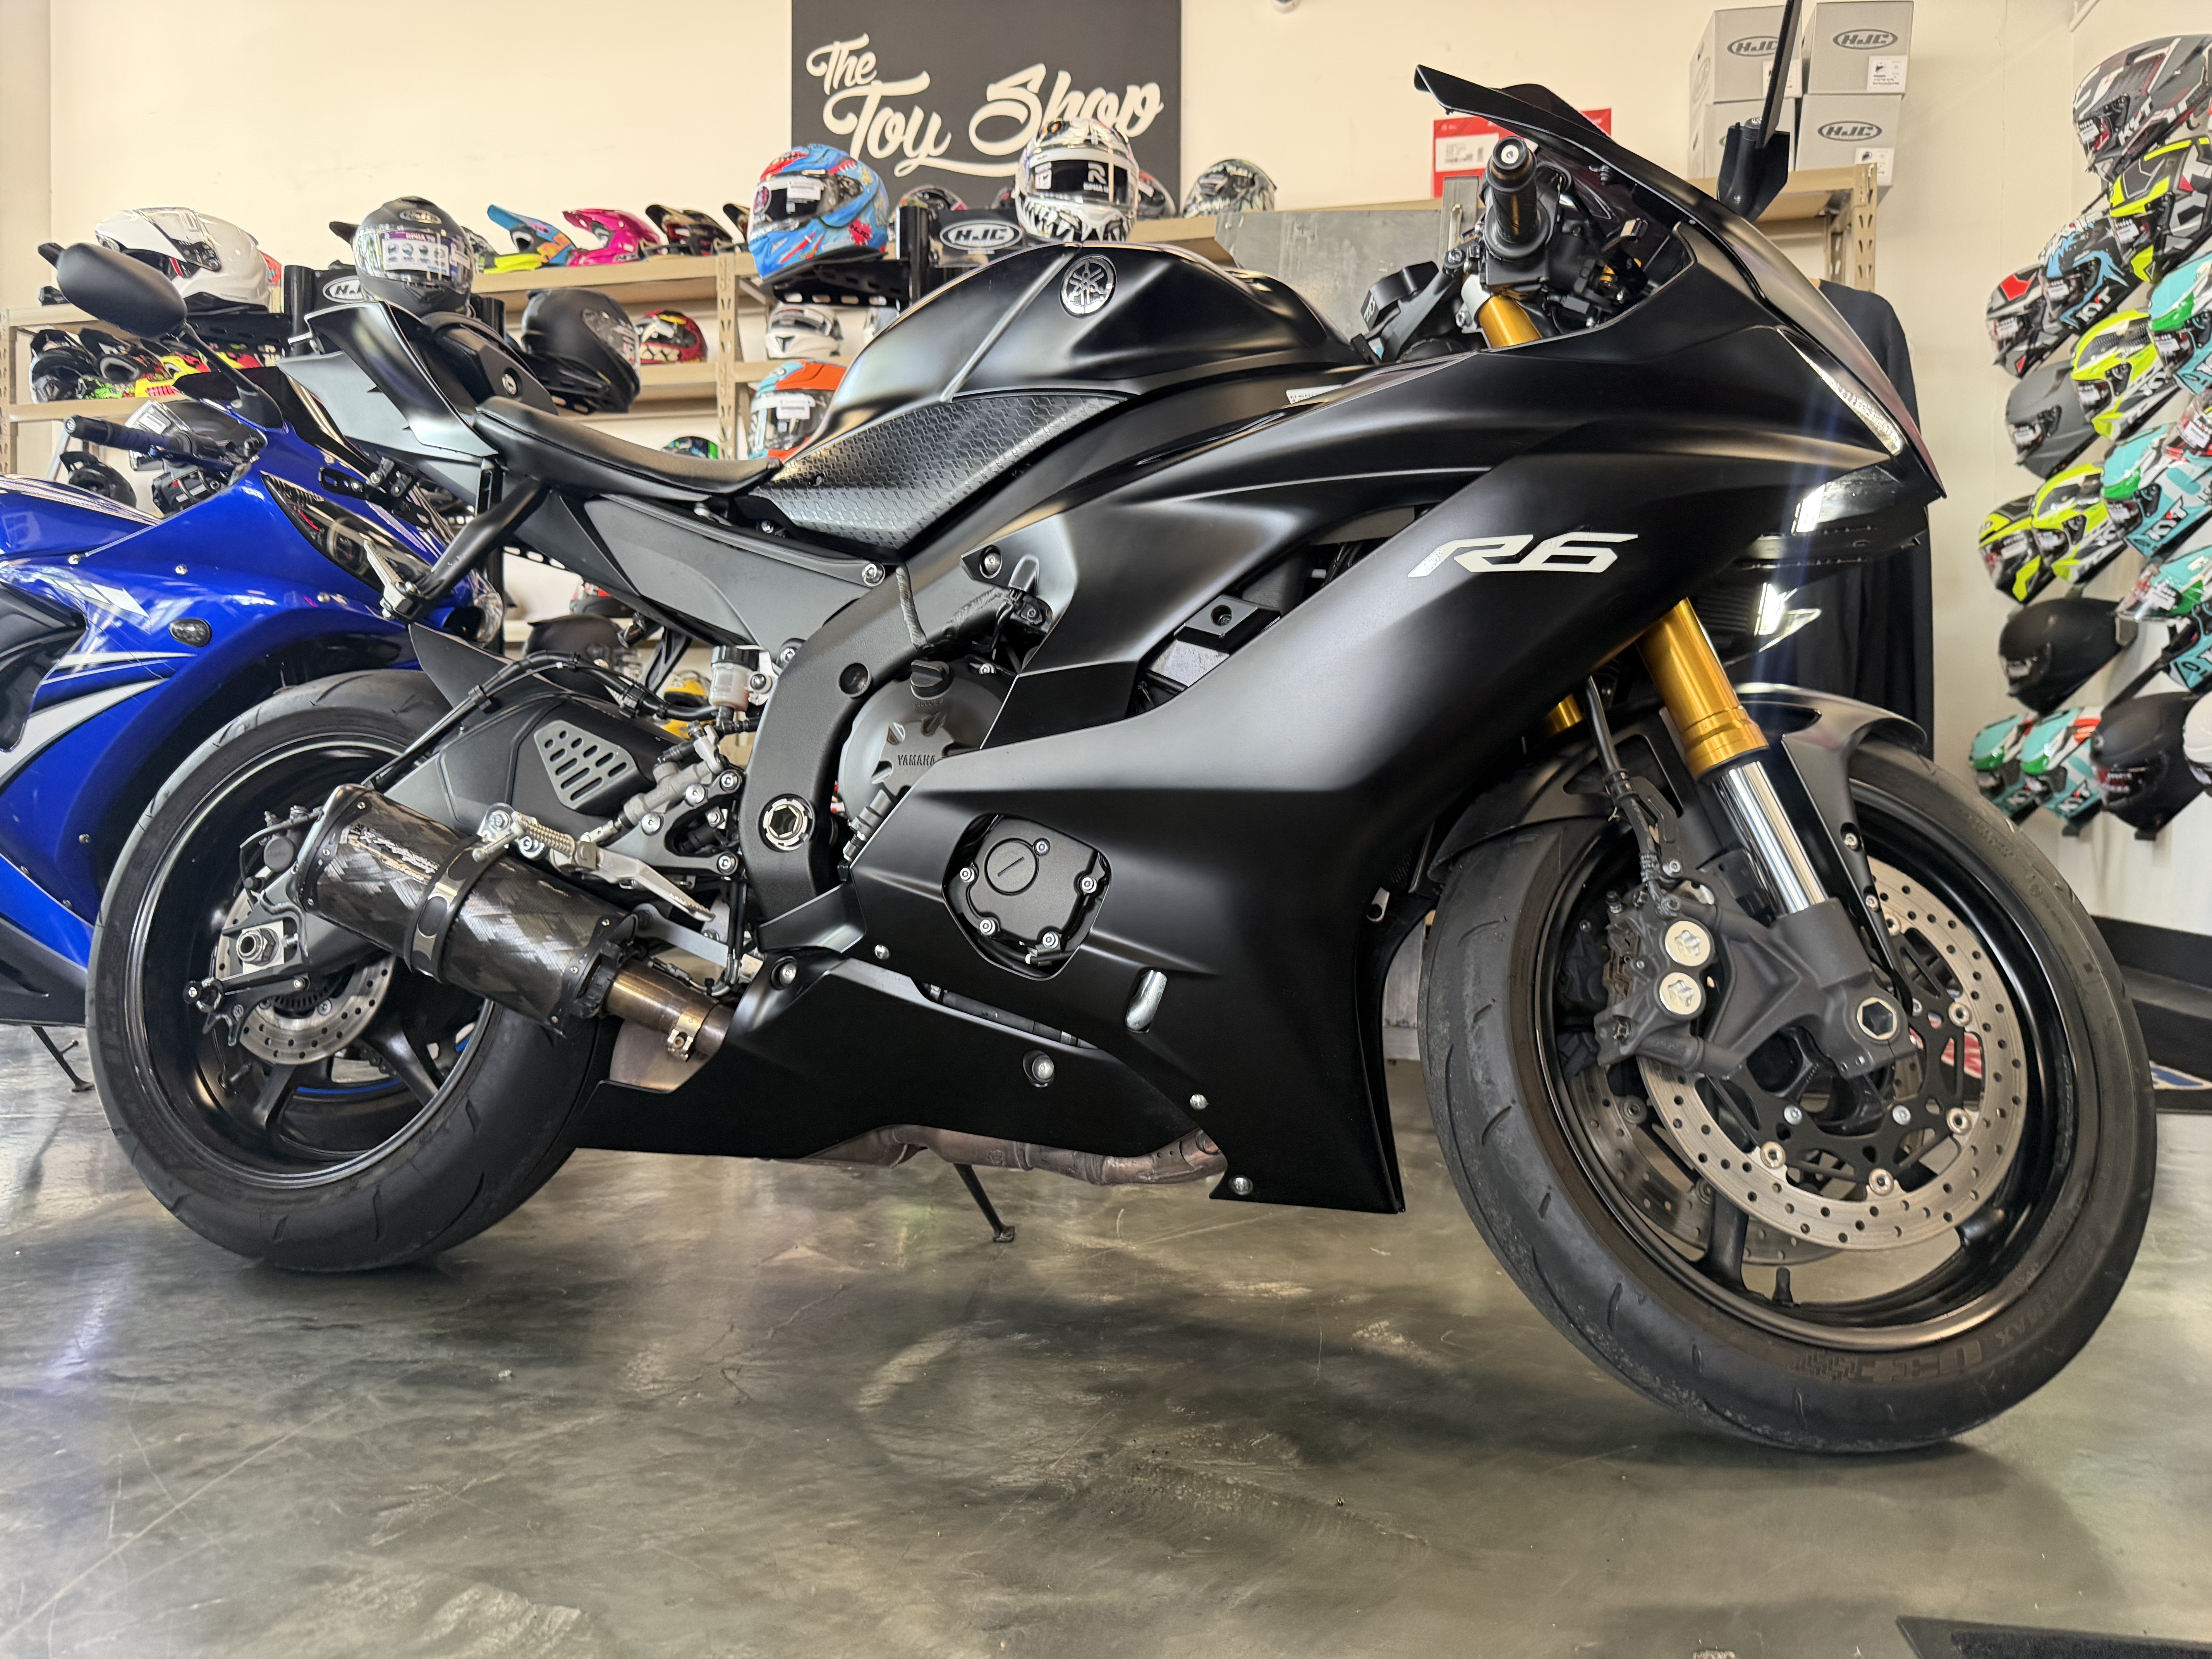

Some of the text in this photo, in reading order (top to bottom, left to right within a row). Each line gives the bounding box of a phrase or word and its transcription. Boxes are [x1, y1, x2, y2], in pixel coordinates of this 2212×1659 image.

[1841, 34, 1889, 45] HJC
[1736, 41, 1778, 52] HJC
[806, 33, 877, 95] The
[823, 63, 1164, 177] Toy Shop
[1826, 126, 1874, 136] HJC
[955, 229, 1007, 241] HJC
[335, 284, 361, 294] HJ
[2145, 499, 2187, 541] KYT
[1407, 531, 1638, 578] R6
[898, 754, 936, 766] YAMAHA
